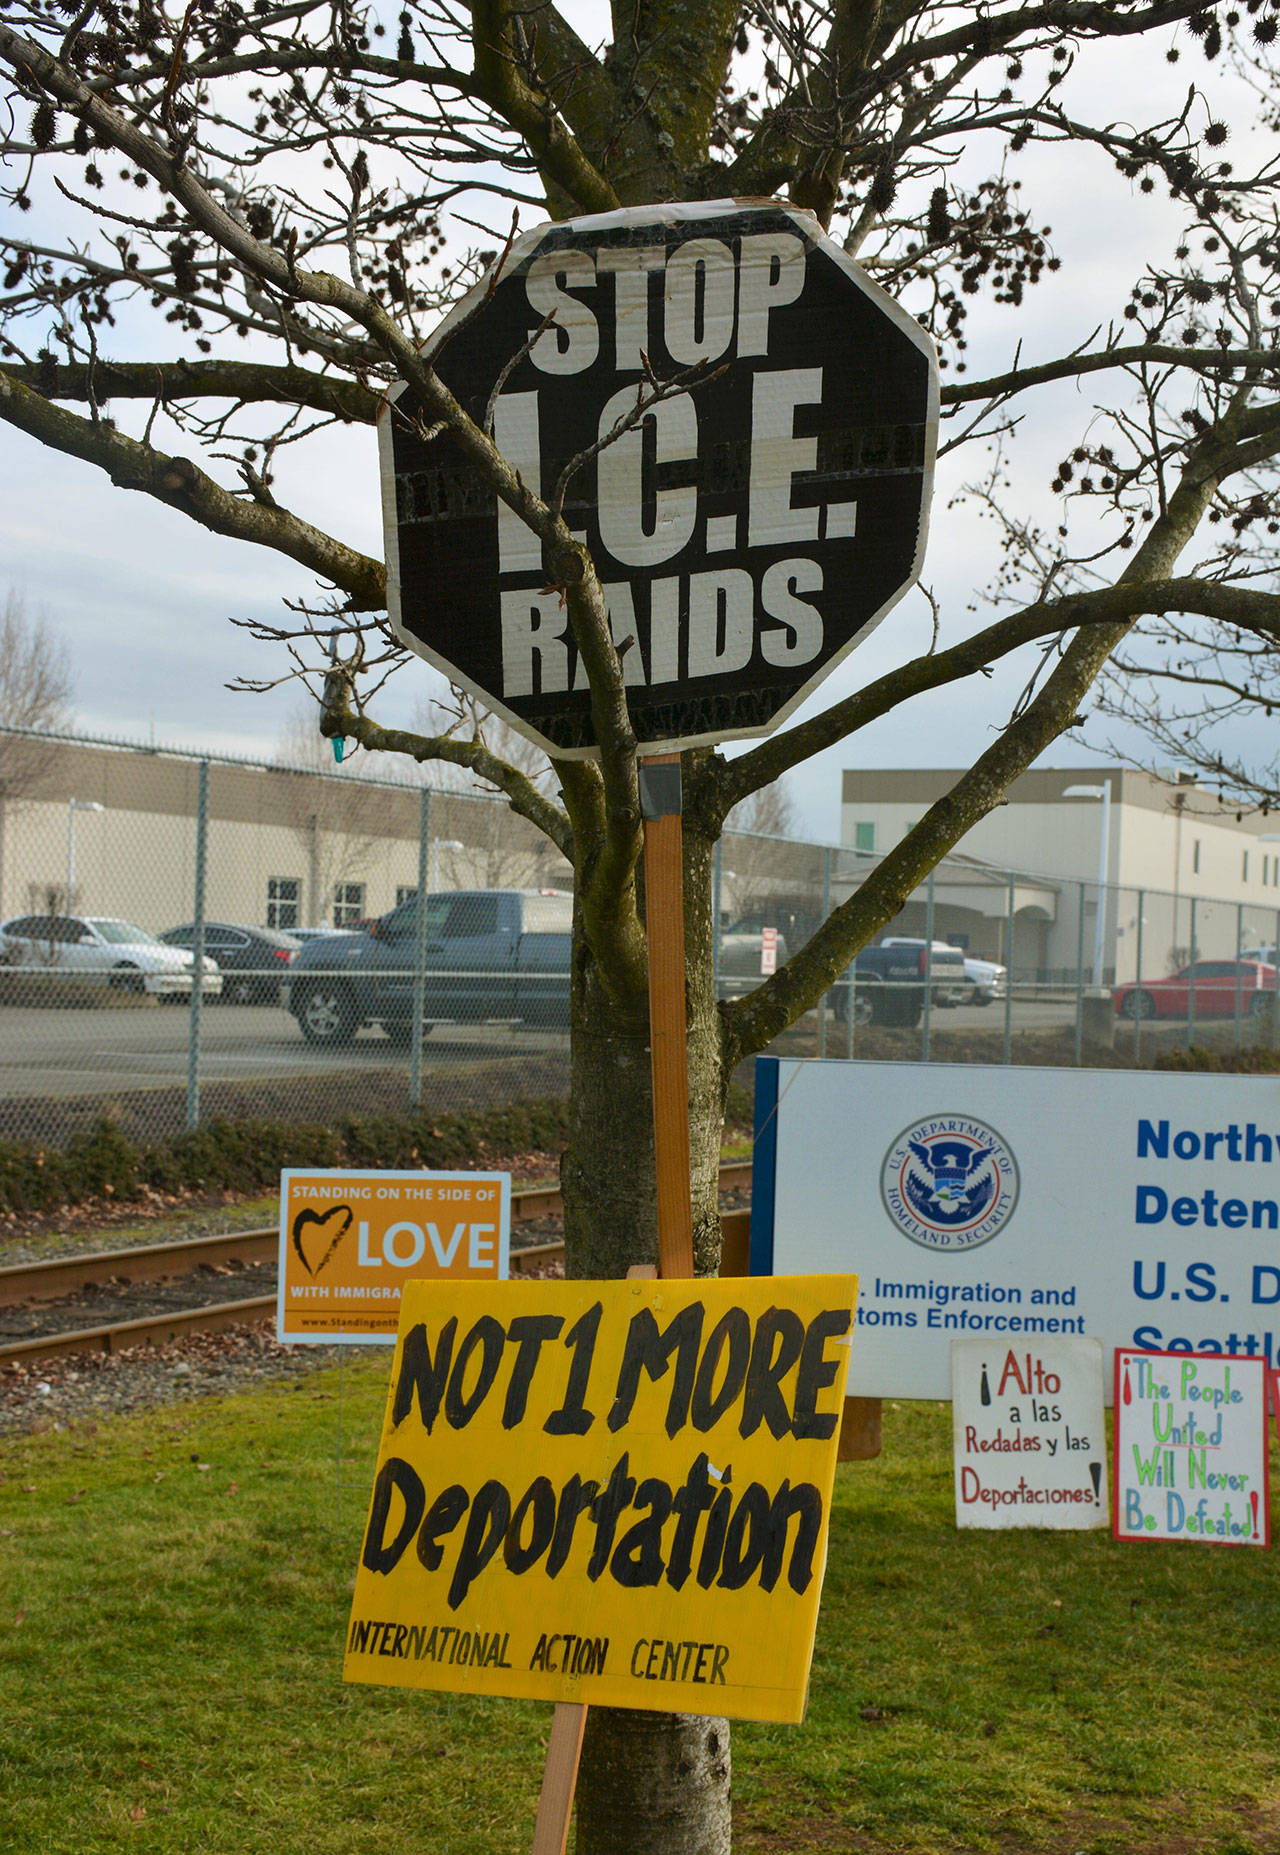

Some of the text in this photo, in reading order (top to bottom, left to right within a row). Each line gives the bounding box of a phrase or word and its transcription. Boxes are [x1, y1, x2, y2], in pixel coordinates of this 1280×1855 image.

[525, 232, 806, 375] STOP
[498, 367, 857, 573] IC.E.
[500, 558, 825, 699] RAIDS
[911, 1120, 1005, 1156] DEPARTMENT
[999, 1157, 1013, 1175] OF
[1137, 1119, 1280, 1162] North
[292, 1185, 496, 1201] STANDING ON THE SIDE OF
[888, 1188, 1012, 1245] HOMELAND SECURITY
[1135, 1185, 1280, 1229] Deten
[357, 1221, 495, 1268] LOVE
[290, 1286, 402, 1299] WITH IMMIGRA
[875, 1278, 1076, 1306] Immigration and
[1133, 1260, 1230, 1302] U.S.
[302, 1317, 399, 1329] www.Standingonth
[854, 1307, 1085, 1334] toms Enforcement
[391, 1300, 852, 1441] NOT 1 MORE
[1133, 1326, 1280, 1369] Seattl
[1181, 1360, 1243, 1409] People
[1009, 1398, 1062, 1423] a las
[1153, 1402, 1222, 1445] United
[966, 1425, 1090, 1456] Redadas y las
[961, 1462, 1102, 1511] Deportaciones!
[1133, 1444, 1249, 1492] Will Never
[362, 1451, 823, 1612] Deportation
[1126, 1488, 1259, 1539] Be Defeated!
[349, 1620, 731, 1686] INTERNATIONAL ACTION CENTER
